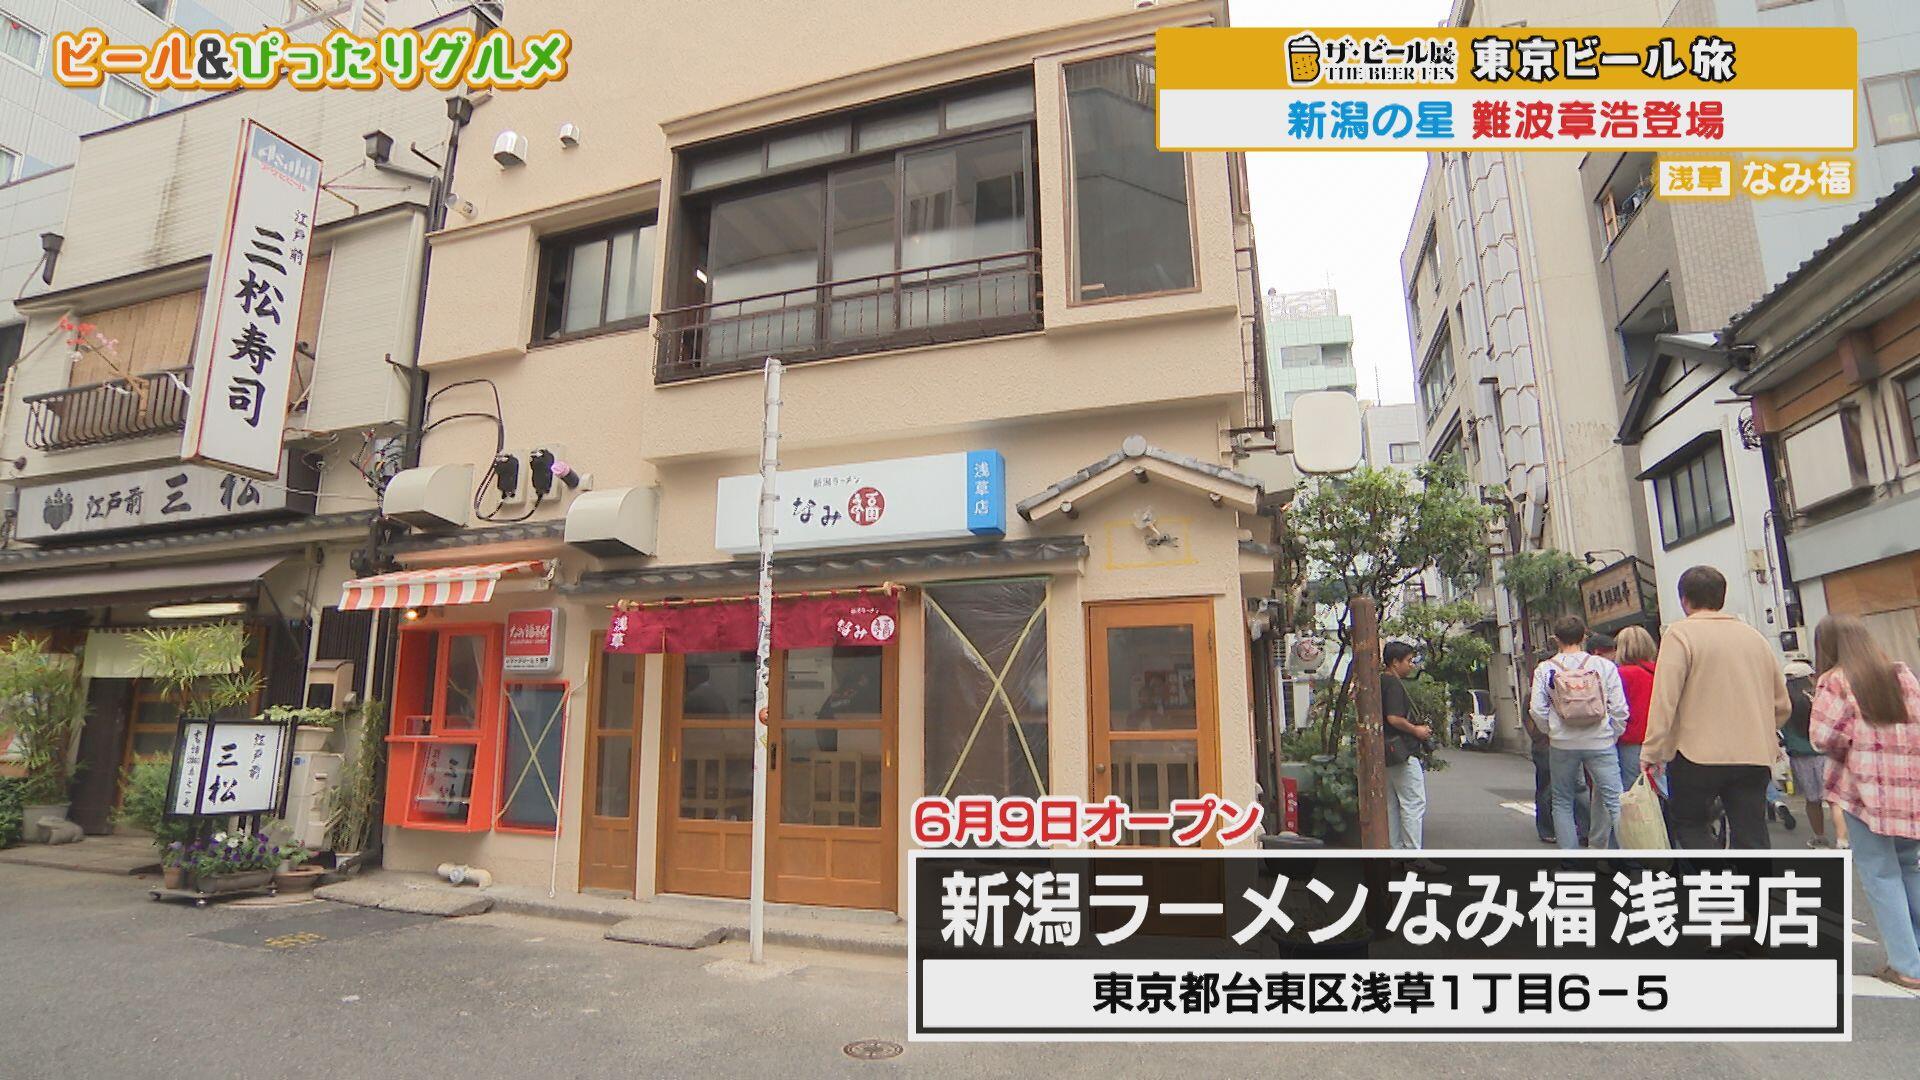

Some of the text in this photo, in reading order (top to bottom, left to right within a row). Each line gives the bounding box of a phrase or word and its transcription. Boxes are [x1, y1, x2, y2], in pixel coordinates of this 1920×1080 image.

[257, 143, 312, 182] Asahi
[227, 225, 288, 428] 三松寿司
[813, 476, 861, 489] 新潟ラーメン
[974, 461, 990, 516] 浅草店
[85, 486, 144, 520] 江戸前
[792, 489, 882, 527] なみ福
[610, 615, 629, 649] 浅草
[208, 742, 239, 805] 三松
